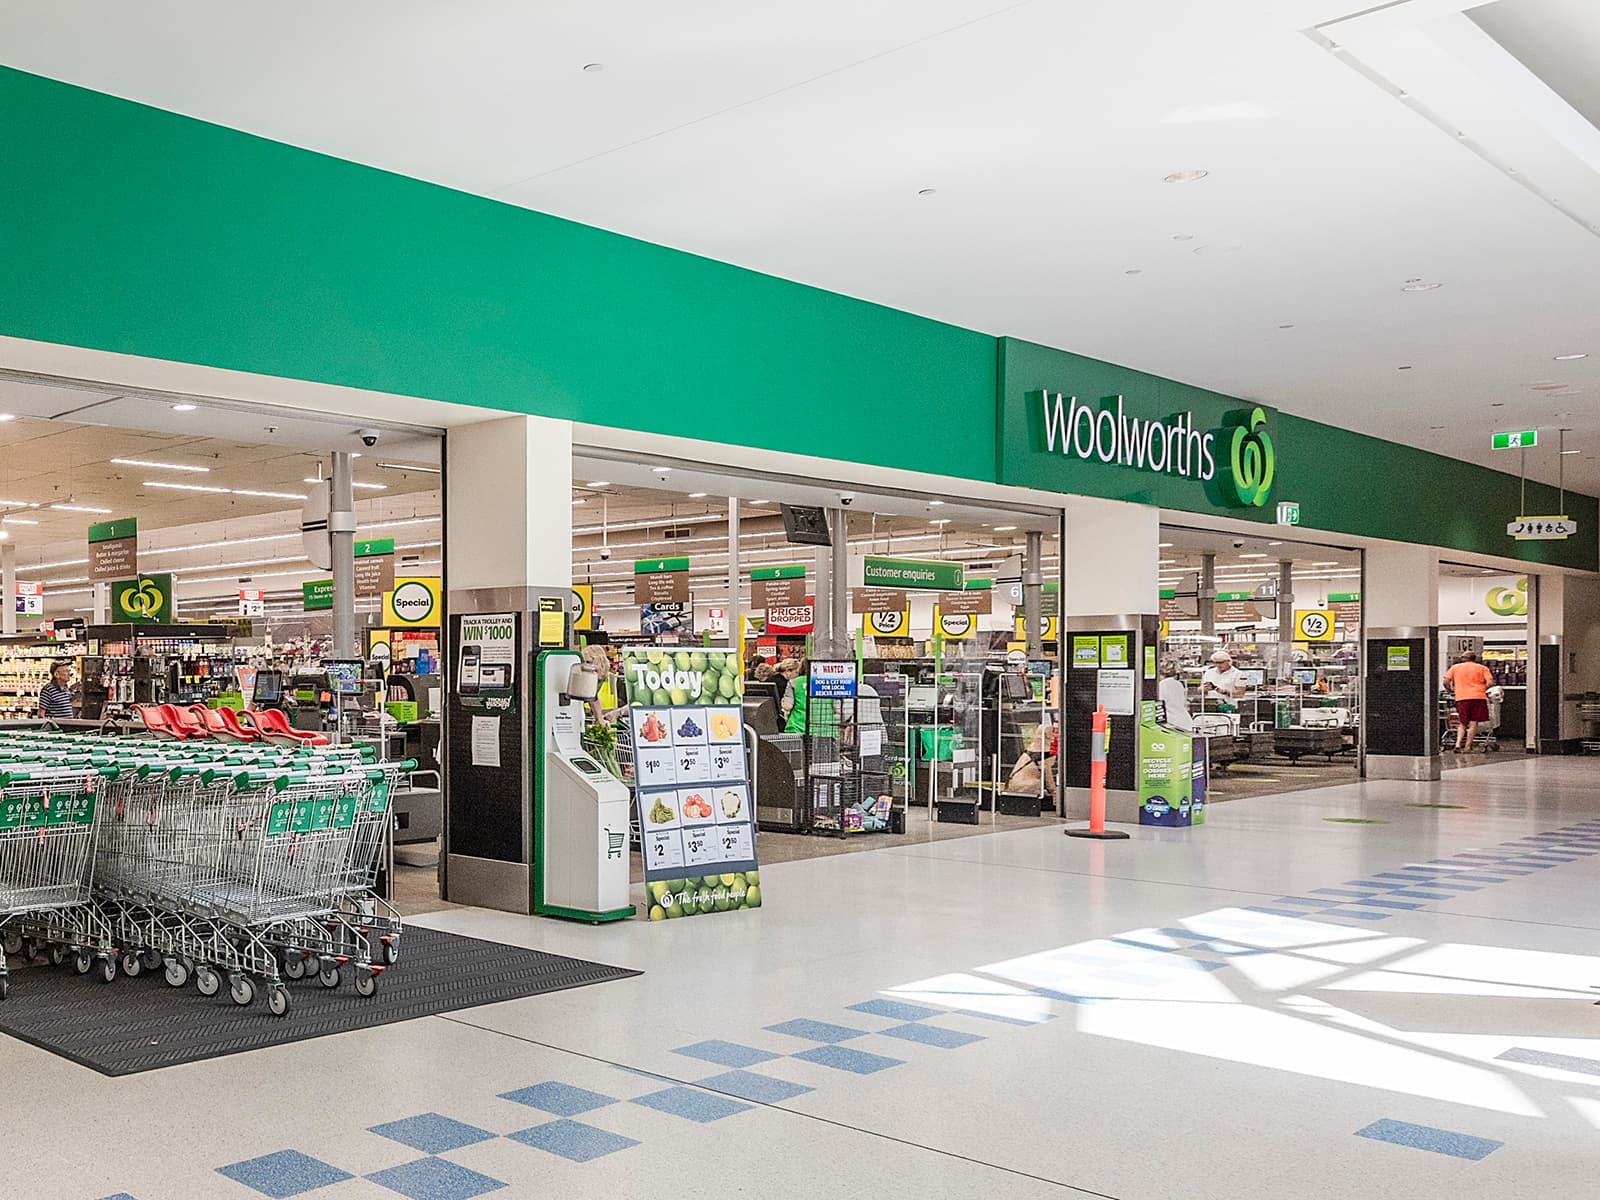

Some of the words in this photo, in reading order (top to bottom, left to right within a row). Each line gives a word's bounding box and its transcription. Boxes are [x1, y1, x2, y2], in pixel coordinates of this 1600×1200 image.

[1043, 389, 1214, 481] Woolworths
[110, 526, 115, 537] 1
[365, 544, 371, 553] 2
[775, 569, 780, 577] 5
[866, 565, 901, 579] Customer
[902, 570, 936, 582] enquiries
[1011, 586, 1019, 598] 6
[1261, 585, 1274, 596] 11
[396, 598, 431, 609] Special
[655, 602, 680, 611] Cards
[770, 607, 811, 616] PRICES
[879, 611, 896, 623] 1/2
[770, 615, 811, 623] DROPPED
[944, 618, 968, 627] Special
[1307, 618, 1322, 630] 1/2
[464, 626, 483, 640] WIN
[484, 625, 513, 640] $1000
[1458, 639, 1473, 651] ICE
[371, 653, 390, 663] Special
[822, 665, 844, 673] WANTED
[631, 663, 702, 698] Today
[692, 831, 706, 839] Special
[726, 828, 740, 836] Special
[655, 834, 670, 842] Special
[654, 844, 665, 856] $2
[674, 891, 690, 905] The
[692, 891, 710, 908] fresh
[711, 887, 725, 904] food
[725, 889, 746, 902] people
